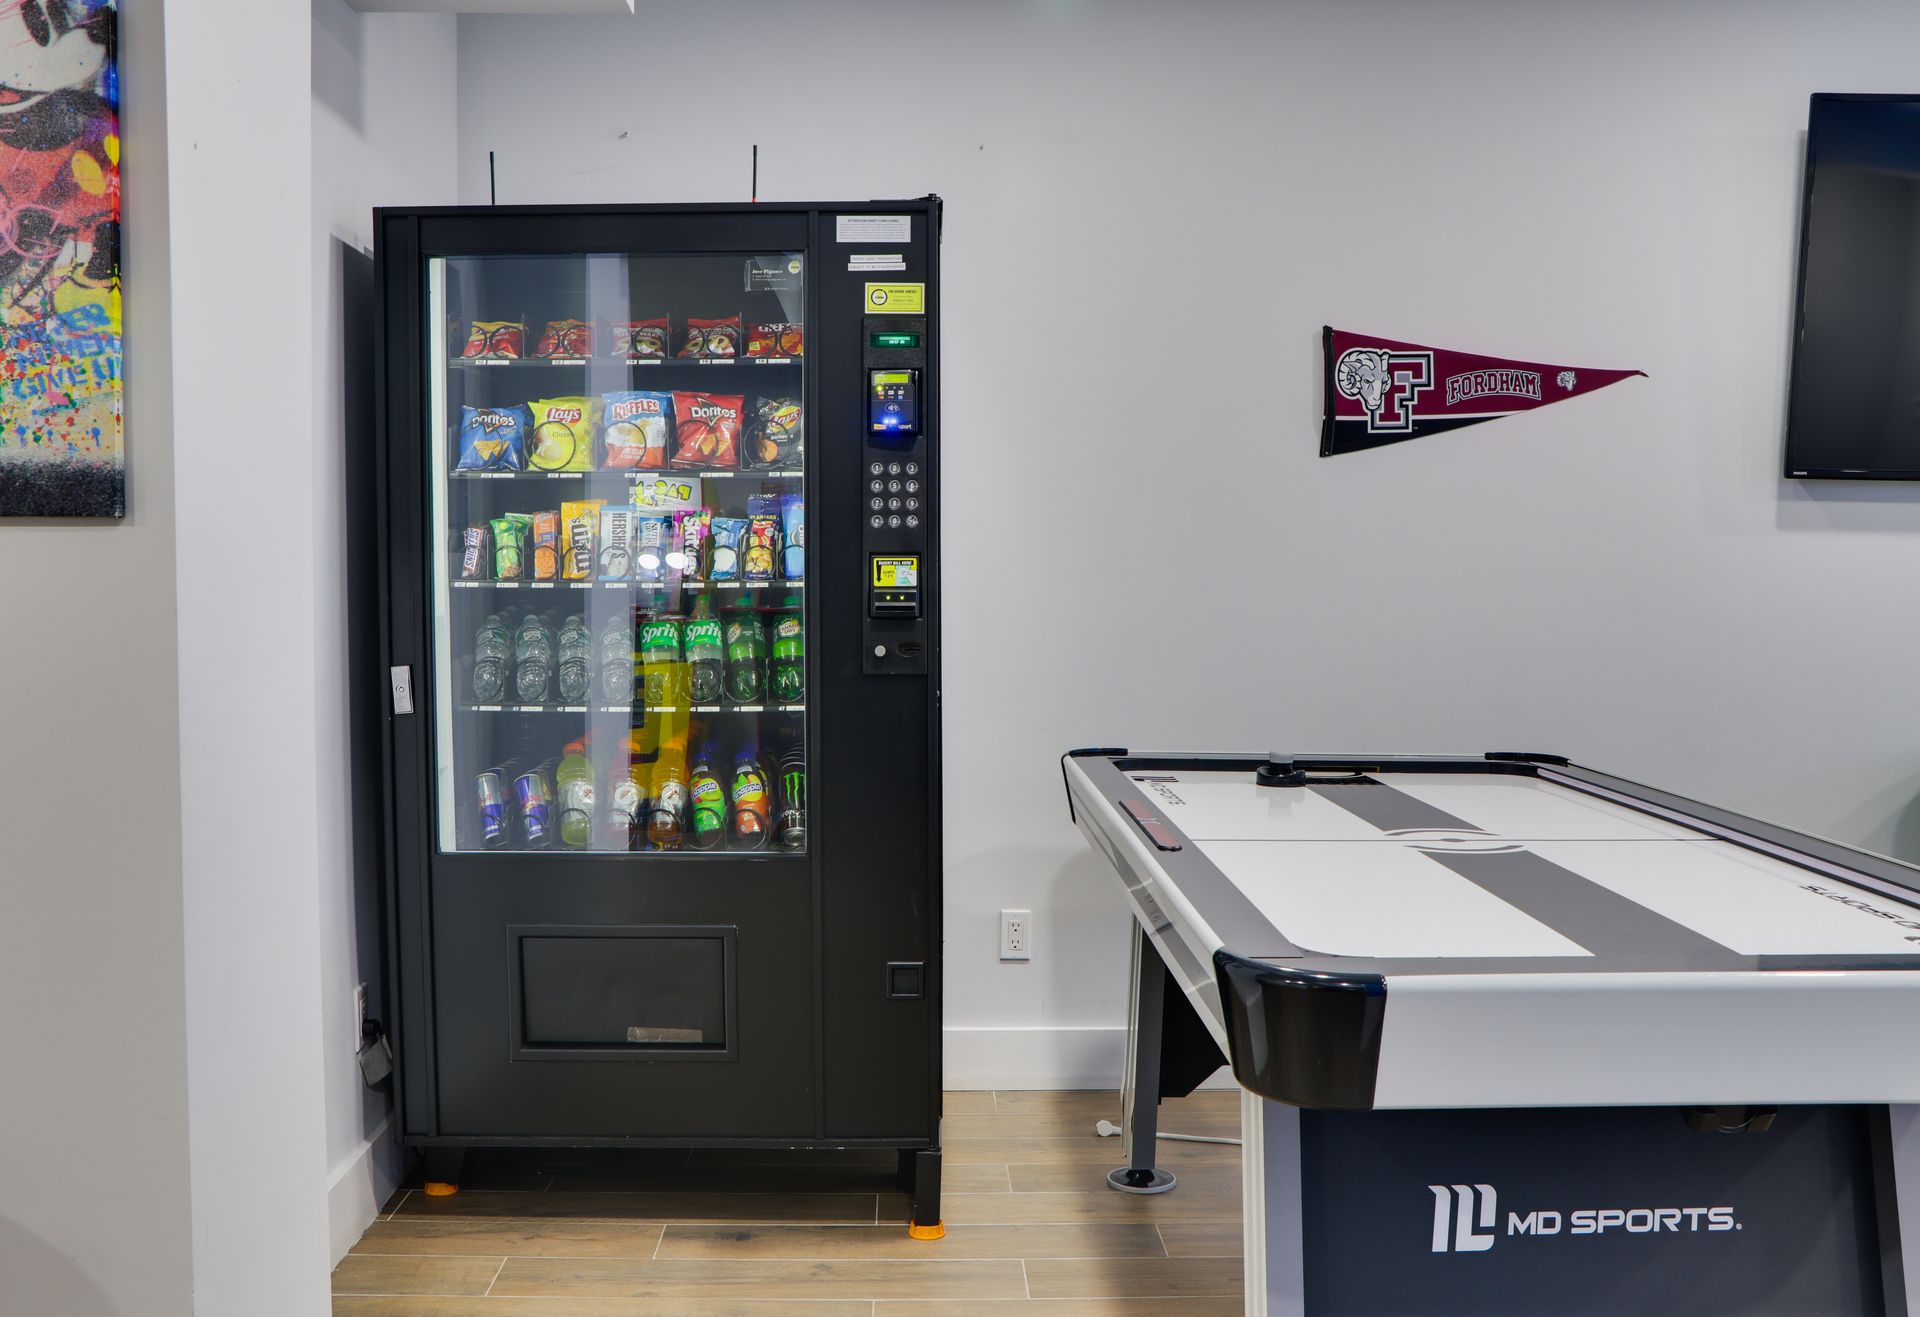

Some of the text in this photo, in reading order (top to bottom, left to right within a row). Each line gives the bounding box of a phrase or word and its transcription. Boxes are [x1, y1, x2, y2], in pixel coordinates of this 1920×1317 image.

[1446, 370, 1542, 404] FORDHAM
[613, 400, 660, 418] RUFFLES
[692, 406, 736, 418] Doritos
[472, 414, 514, 428] Doritos
[1508, 1207, 1734, 1236] MD SPORTS
